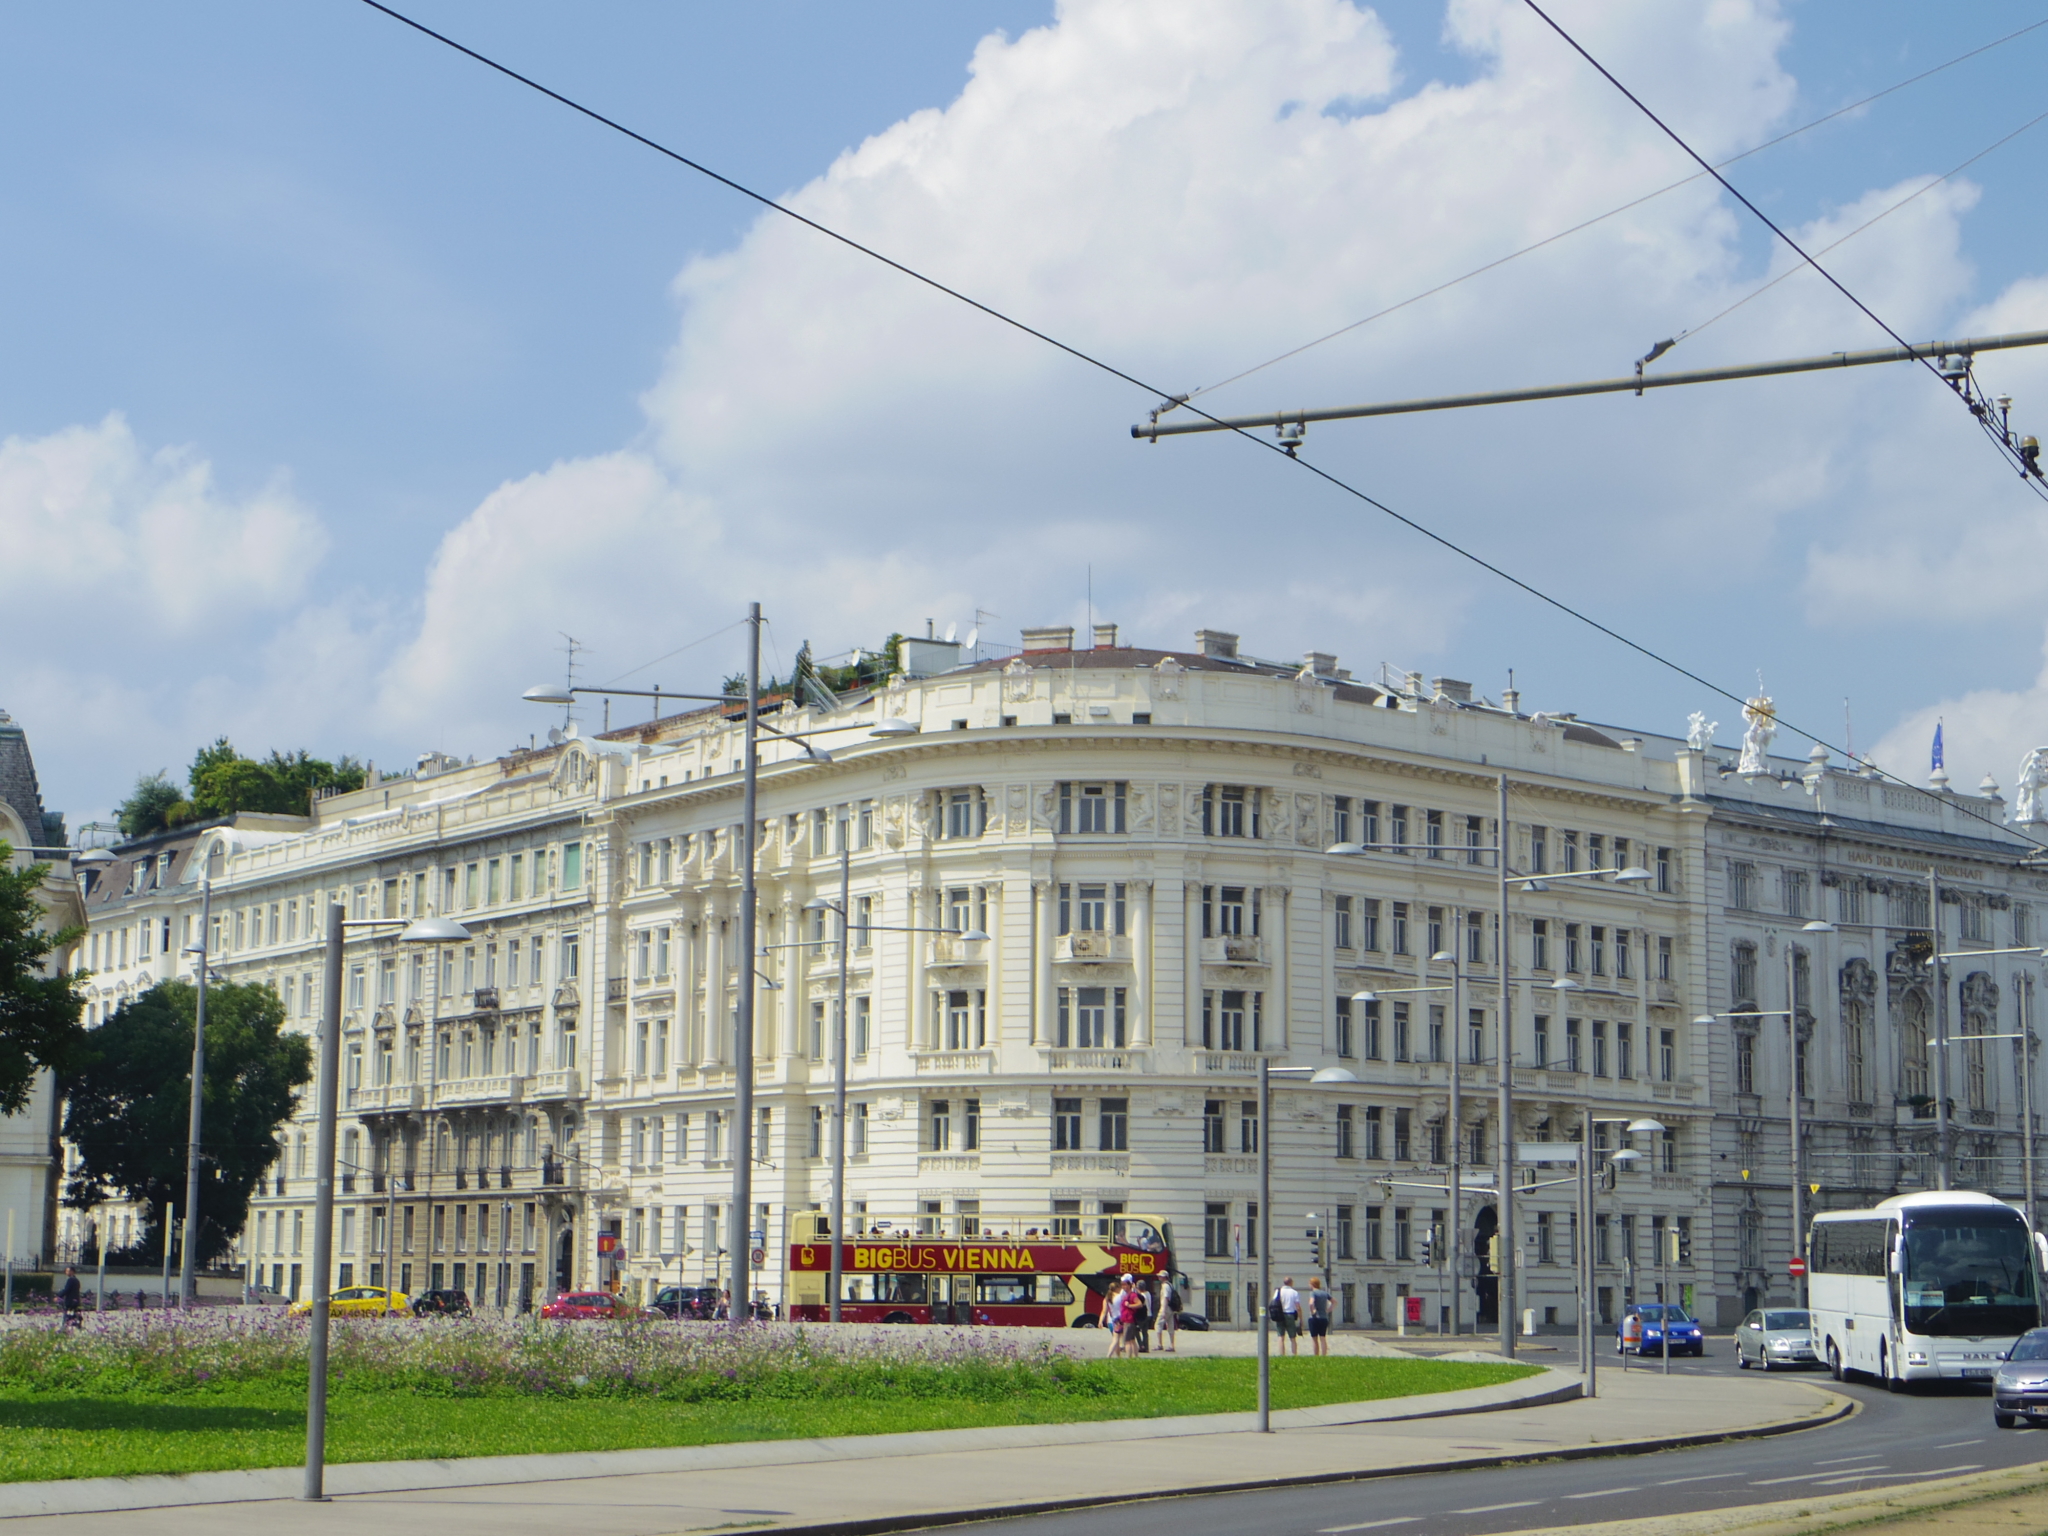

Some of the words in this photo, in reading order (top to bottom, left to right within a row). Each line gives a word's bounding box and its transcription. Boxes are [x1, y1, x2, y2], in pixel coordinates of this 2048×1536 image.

[854, 1248, 936, 1269] BIGBUS
[943, 1248, 1035, 1269] VIENNA
[1120, 1253, 1139, 1264] BIG
[1120, 1263, 1139, 1273] BUS
